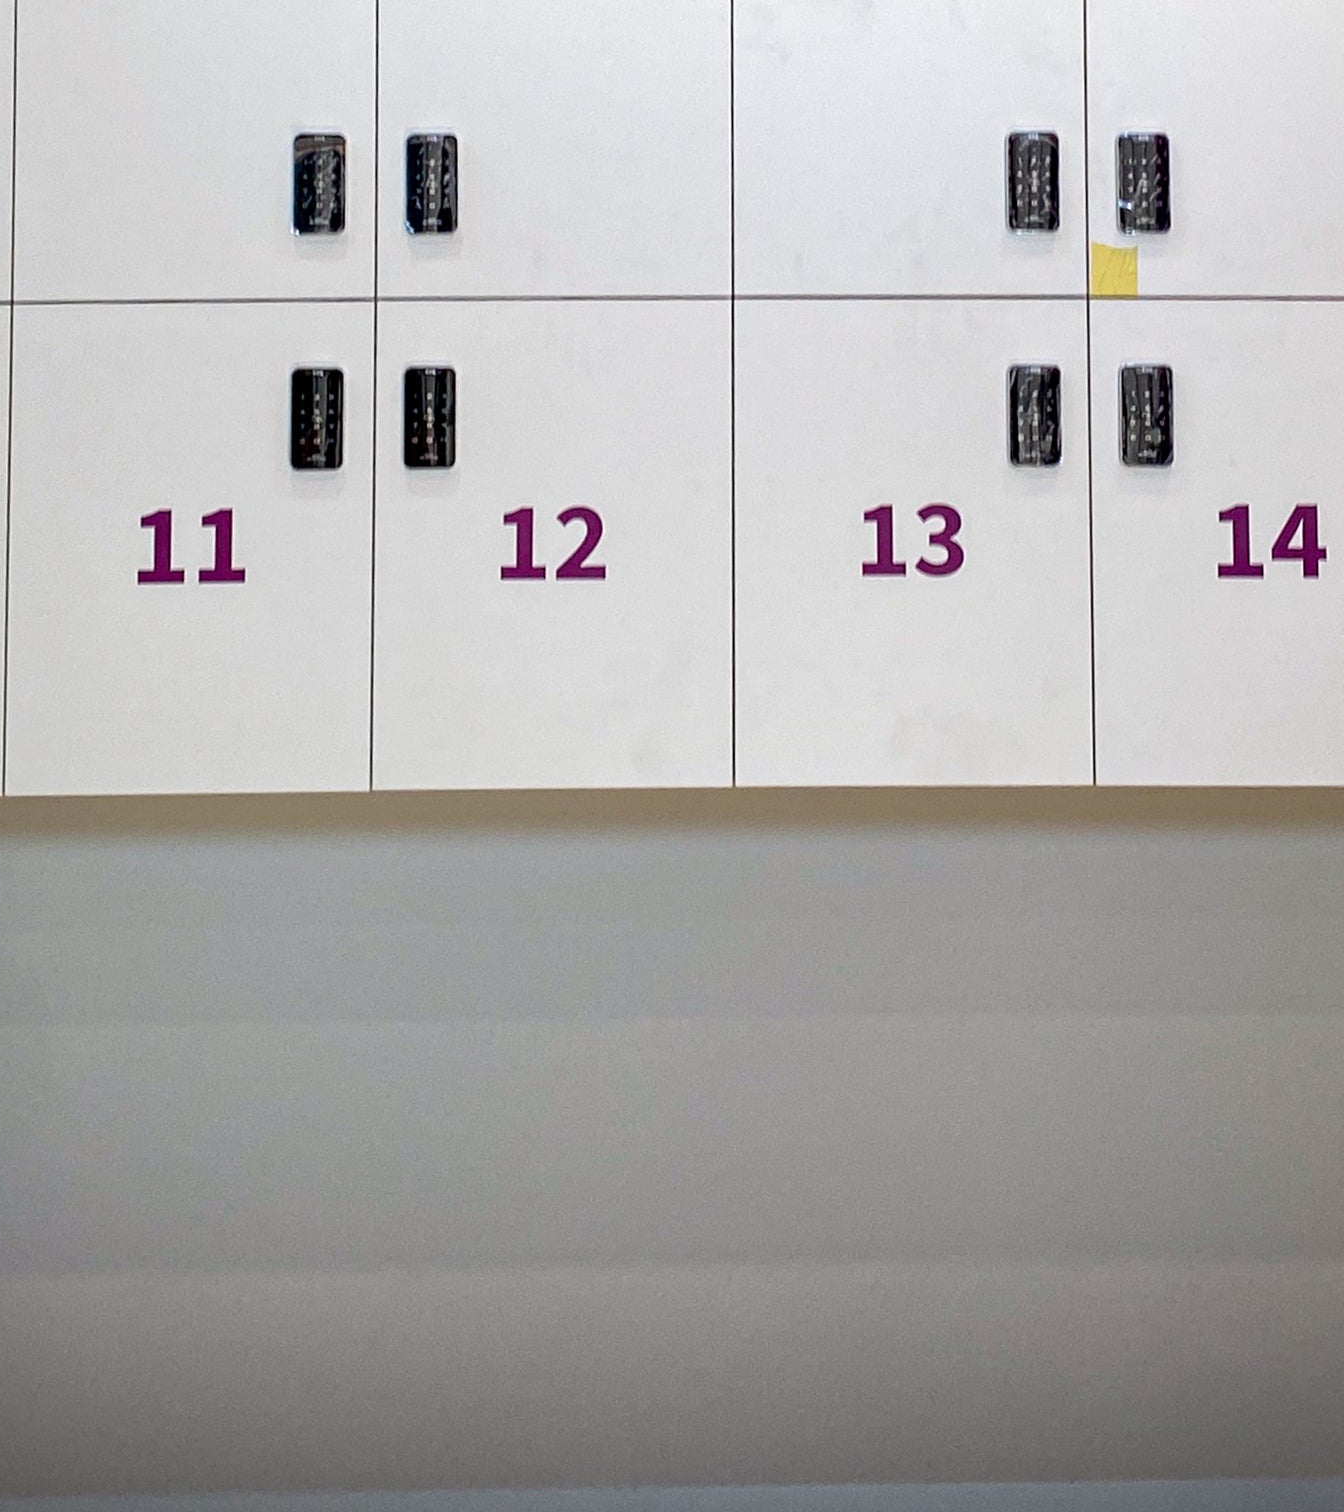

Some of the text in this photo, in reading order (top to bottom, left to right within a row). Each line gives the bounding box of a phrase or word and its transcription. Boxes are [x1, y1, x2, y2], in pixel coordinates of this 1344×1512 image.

[138, 509, 245, 584] 11
[501, 507, 606, 579] 12
[862, 505, 964, 576] 13
[1218, 505, 1326, 578] 14
